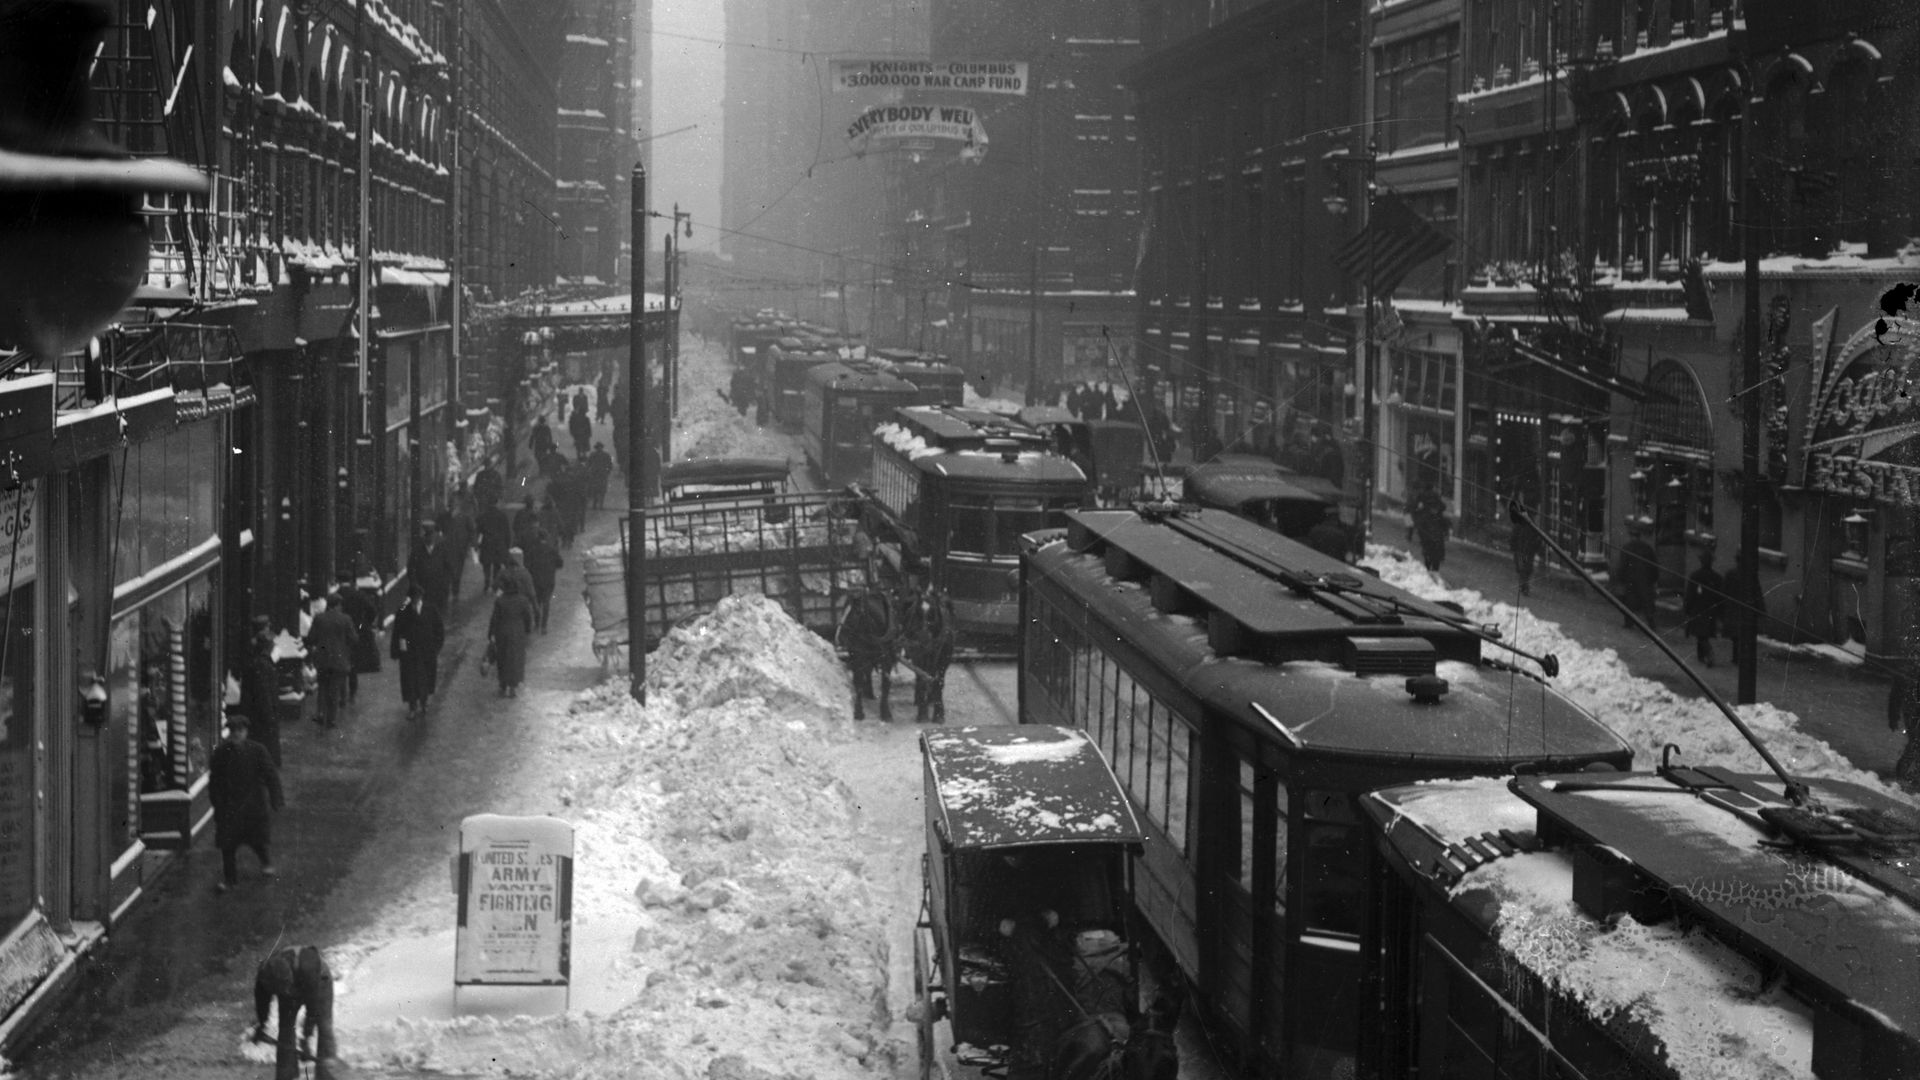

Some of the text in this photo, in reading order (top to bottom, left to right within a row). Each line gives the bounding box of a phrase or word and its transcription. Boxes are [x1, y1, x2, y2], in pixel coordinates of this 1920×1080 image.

[869, 61, 933, 73] KNIGHTS
[949, 62, 1016, 75] COLUMBUS
[924, 75, 950, 87] WAR
[954, 76, 985, 88] CAMP
[989, 76, 1021, 90] FUND
[848, 106, 933, 139] EVERYBODY
[481, 852, 553, 865] UNITED SES
[492, 867, 541, 881] ARMY
[480, 894, 553, 911] FIGHTING
